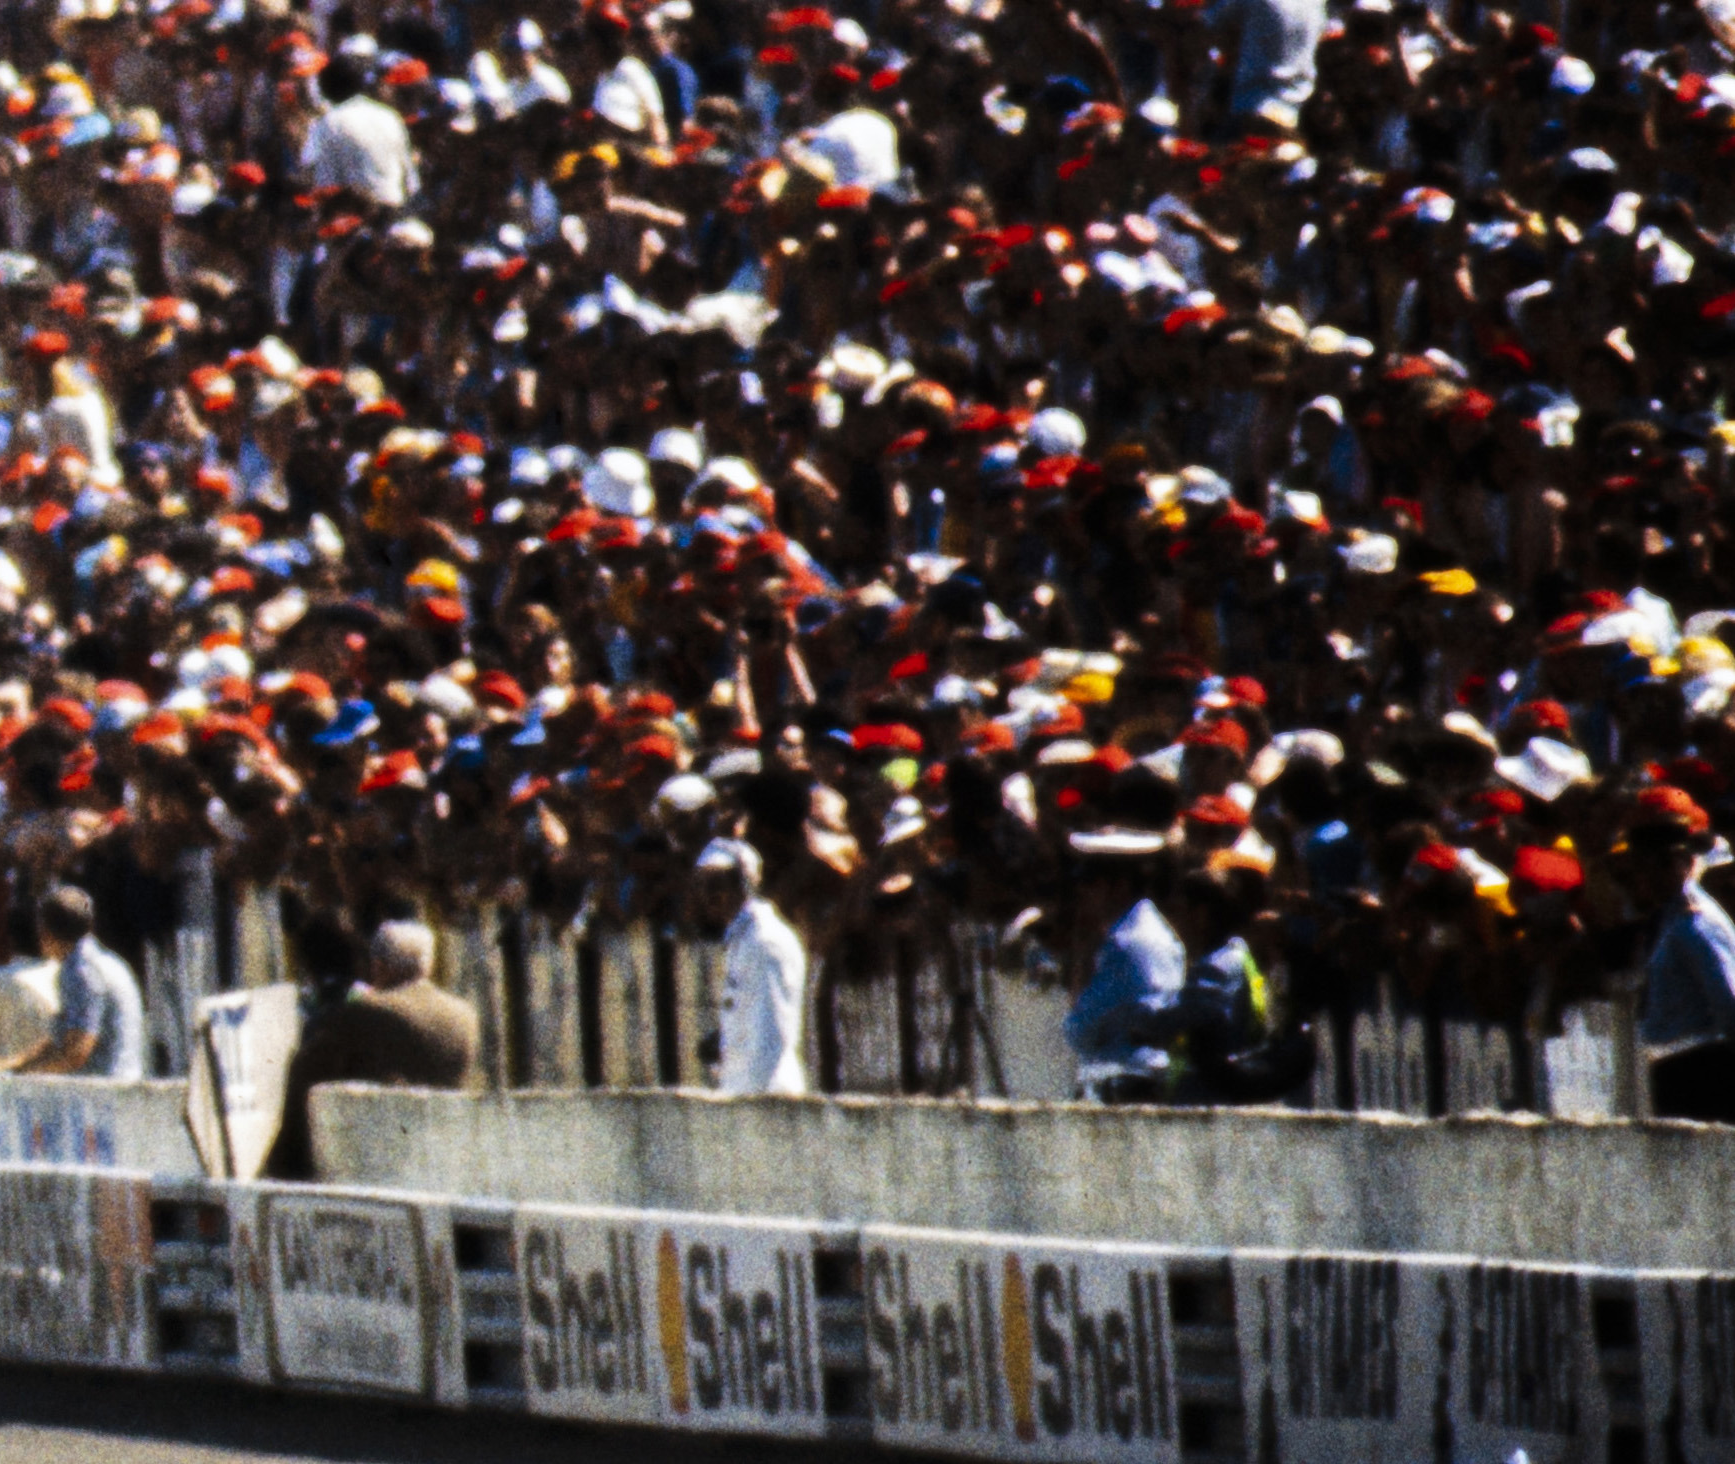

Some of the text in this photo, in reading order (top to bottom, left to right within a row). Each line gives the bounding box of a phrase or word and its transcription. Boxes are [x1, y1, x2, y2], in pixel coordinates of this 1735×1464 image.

[525, 1224, 648, 1395] Shell
[687, 1242, 819, 1416] Shell
[867, 1245, 999, 1434] Shell
[1033, 1262, 1173, 1443] Shell
